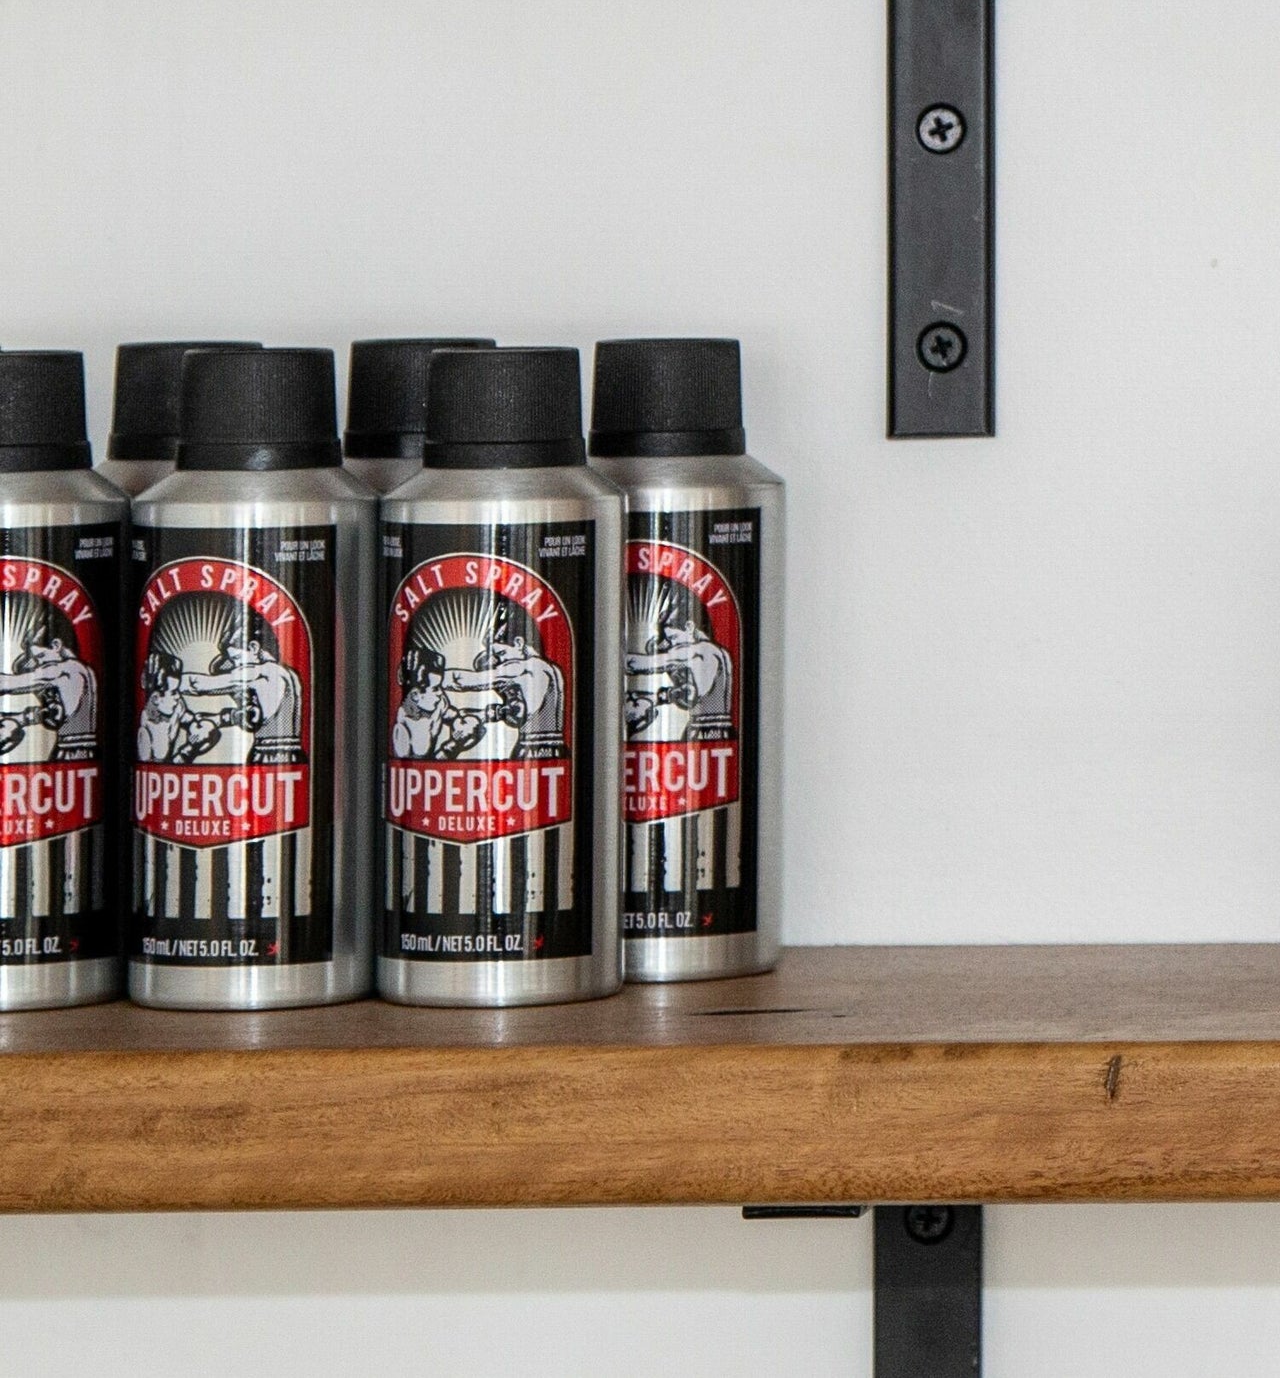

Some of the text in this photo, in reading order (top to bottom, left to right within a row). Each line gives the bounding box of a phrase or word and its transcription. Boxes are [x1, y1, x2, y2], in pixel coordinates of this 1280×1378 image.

[140, 566, 296, 629] SALT SPRAY
[394, 563, 560, 622] SALT SPRAY
[135, 770, 302, 823] UPPERCUT
[390, 767, 564, 818] UPPERCUT
[175, 821, 231, 836] DELUXE
[438, 816, 497, 831] DELUXE
